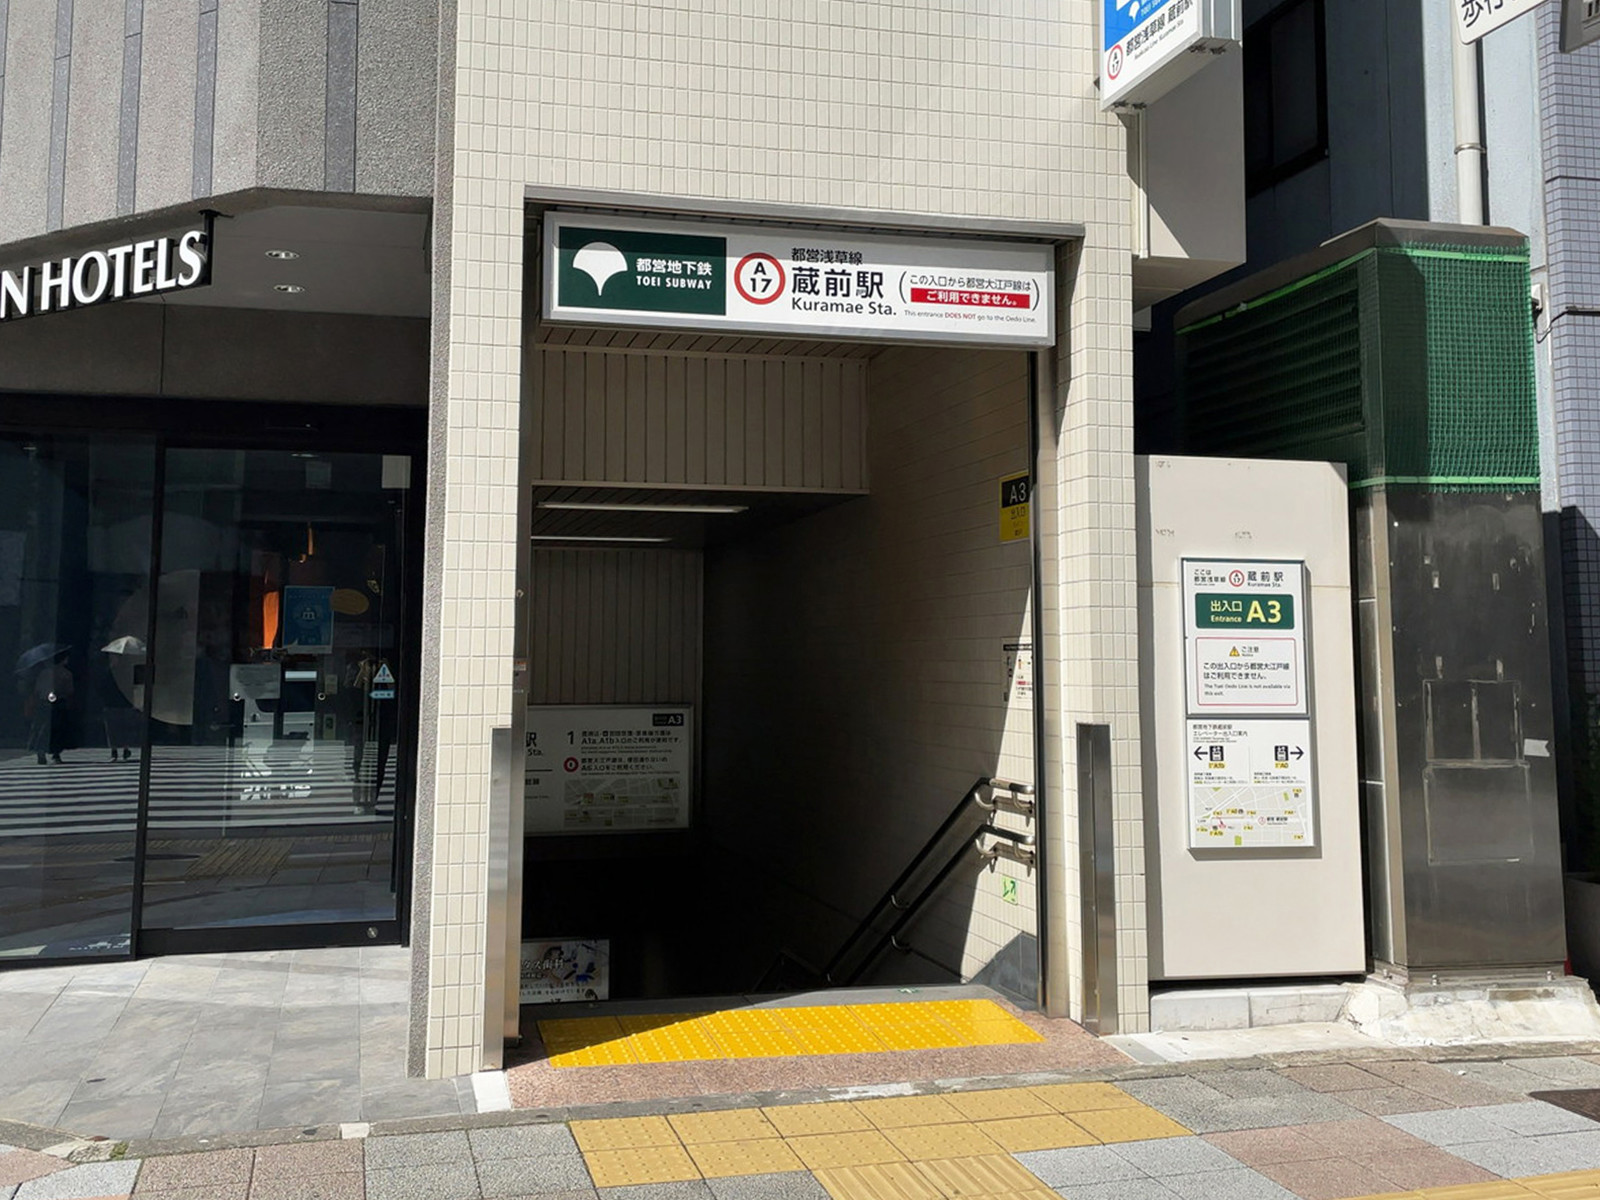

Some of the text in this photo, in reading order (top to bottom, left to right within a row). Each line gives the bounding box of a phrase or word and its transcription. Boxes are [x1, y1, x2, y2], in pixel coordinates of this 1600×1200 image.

[1113, 52, 1118, 61] A
[1112, 60, 1120, 73] 17
[792, 248, 863, 266] 都営浅草線
[40, 230, 206, 311] HOTELS
[636, 258, 712, 276] 都営地下鉄
[754, 261, 766, 276] A
[636, 276, 712, 290] TOEI SUBWAY
[750, 278, 772, 292] 17
[792, 266, 884, 299] 蔵前駅
[910, 274, 1032, 291] この入口から都営大江戸線は
[926, 290, 1017, 306] ご利用できません。
[792, 297, 897, 316] Kuramae Sta.
[1010, 482, 1026, 504] A3
[1247, 570, 1284, 582] 蔵前駅
[1210, 600, 1242, 612] 出入口
[1246, 600, 1282, 623] A3
[1210, 614, 1242, 622] Entrance
[1203, 662, 1290, 670] この出入口から都営大江戸線
[667, 715, 682, 725] A3
